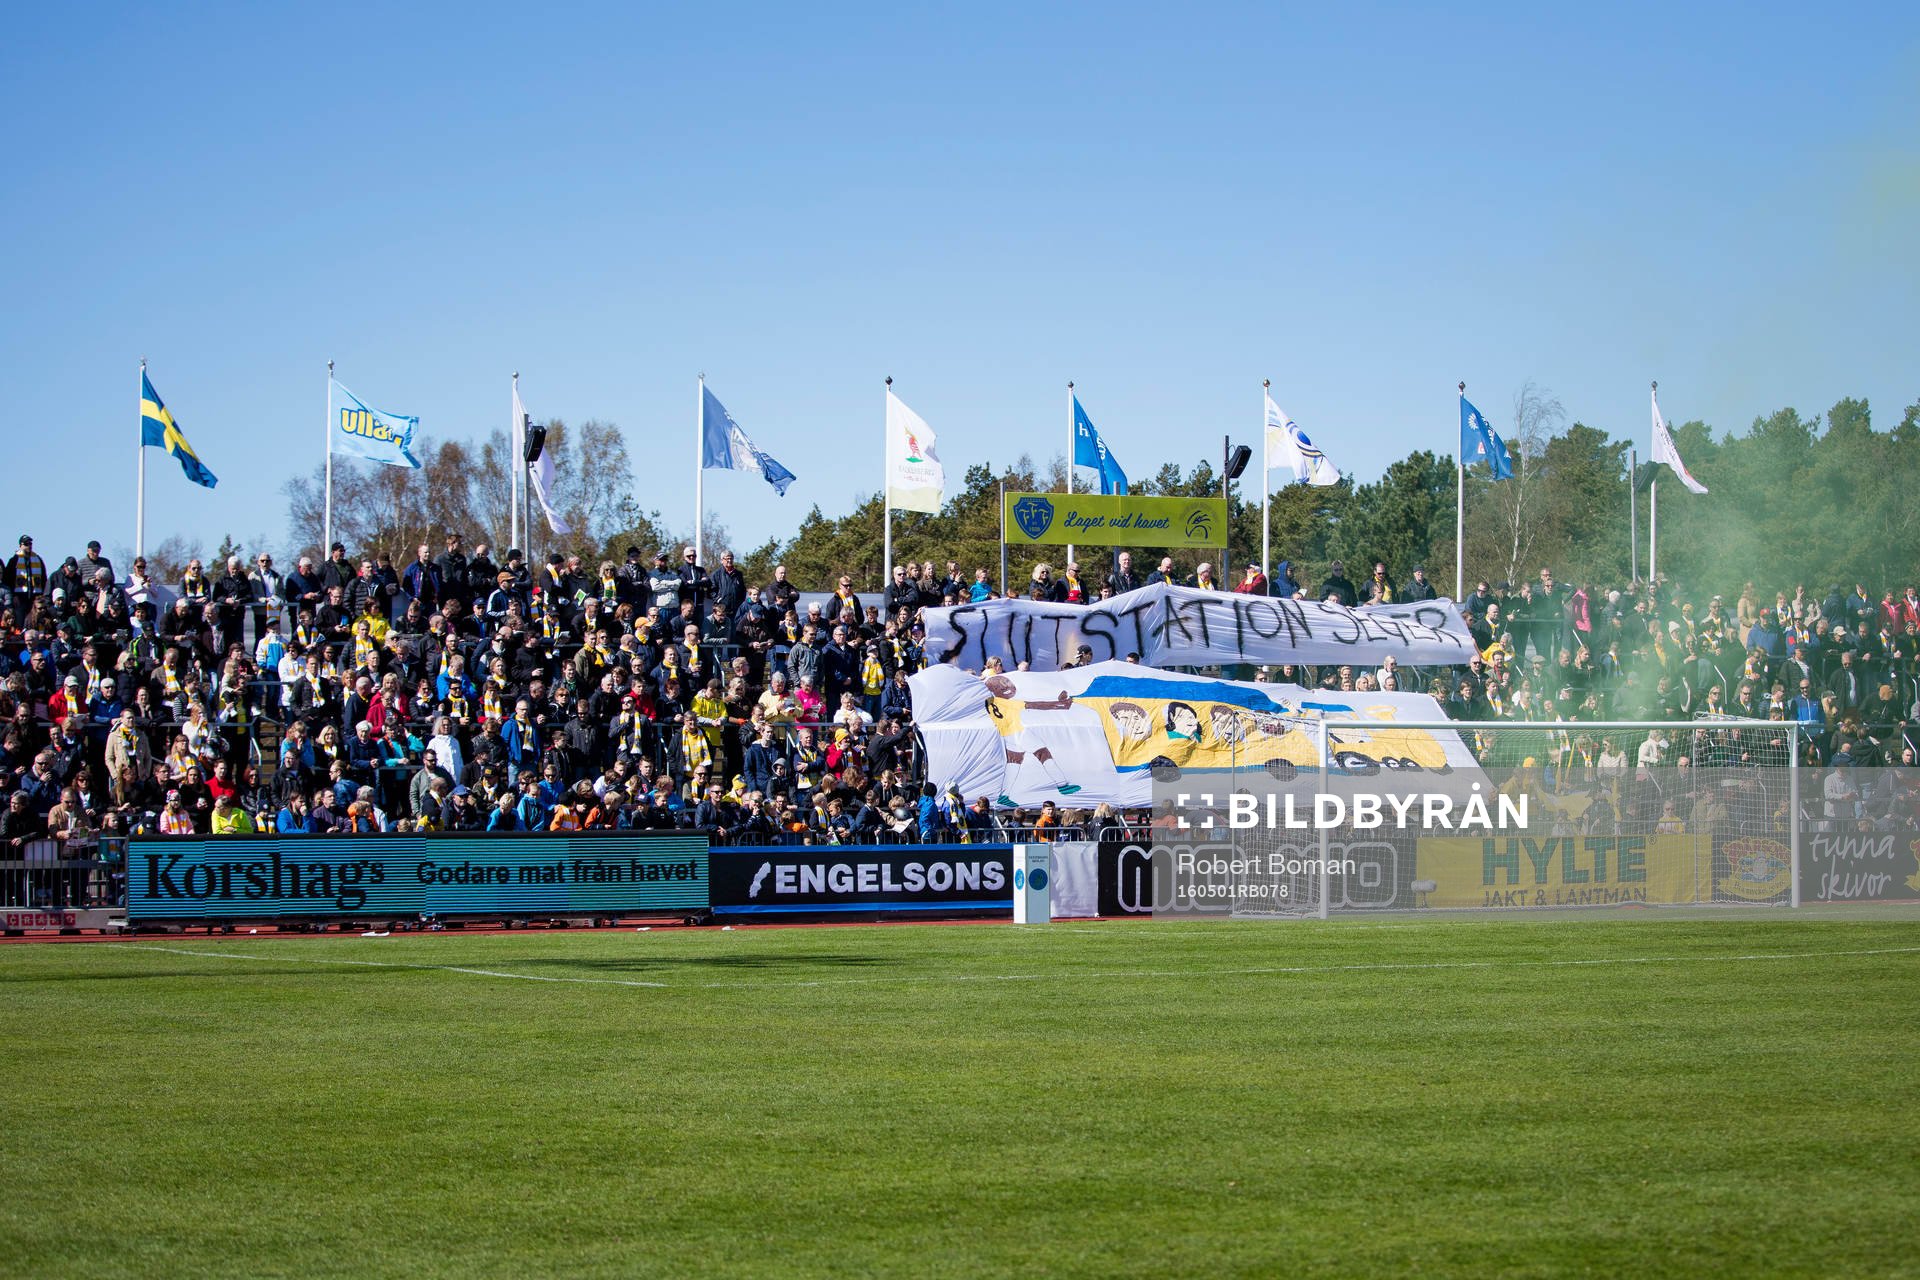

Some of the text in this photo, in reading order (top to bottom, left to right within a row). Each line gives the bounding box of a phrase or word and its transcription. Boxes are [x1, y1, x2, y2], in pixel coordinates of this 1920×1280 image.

[1064, 511, 1170, 533] Laget vid havet
[1482, 836, 1647, 886] HYLTE
[1809, 833, 1896, 862] tunna
[417, 861, 510, 884] Godare
[519, 860, 566, 884] mat
[573, 858, 622, 882] från
[631, 858, 699, 881] havet
[775, 861, 1006, 894] ENGELSONS
[1817, 854, 1892, 900] skivor
[1482, 886, 1647, 908] JAKT & LANTMAN
